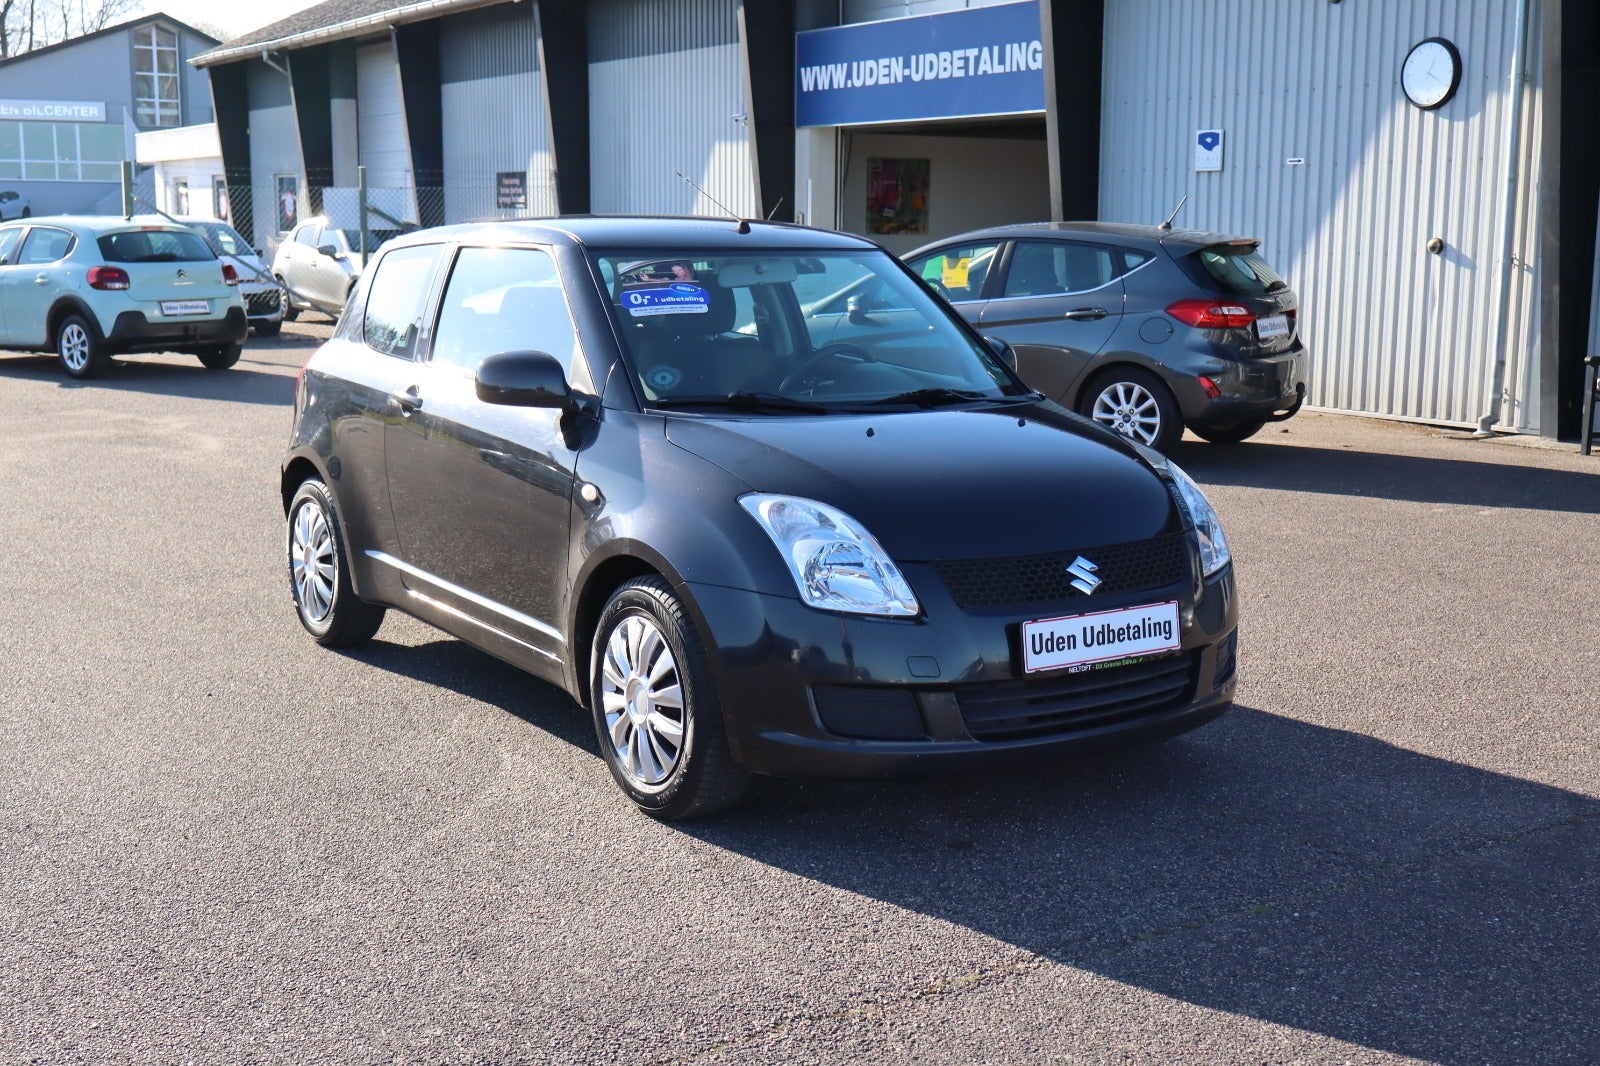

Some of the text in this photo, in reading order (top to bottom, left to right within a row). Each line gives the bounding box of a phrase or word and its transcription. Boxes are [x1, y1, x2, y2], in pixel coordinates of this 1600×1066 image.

[800, 40, 1043, 92] WWW.UDEN-UDBETALING
[23, 105, 98, 117] BILCENTER
[1031, 617, 1172, 655] Uden Udbetaling
